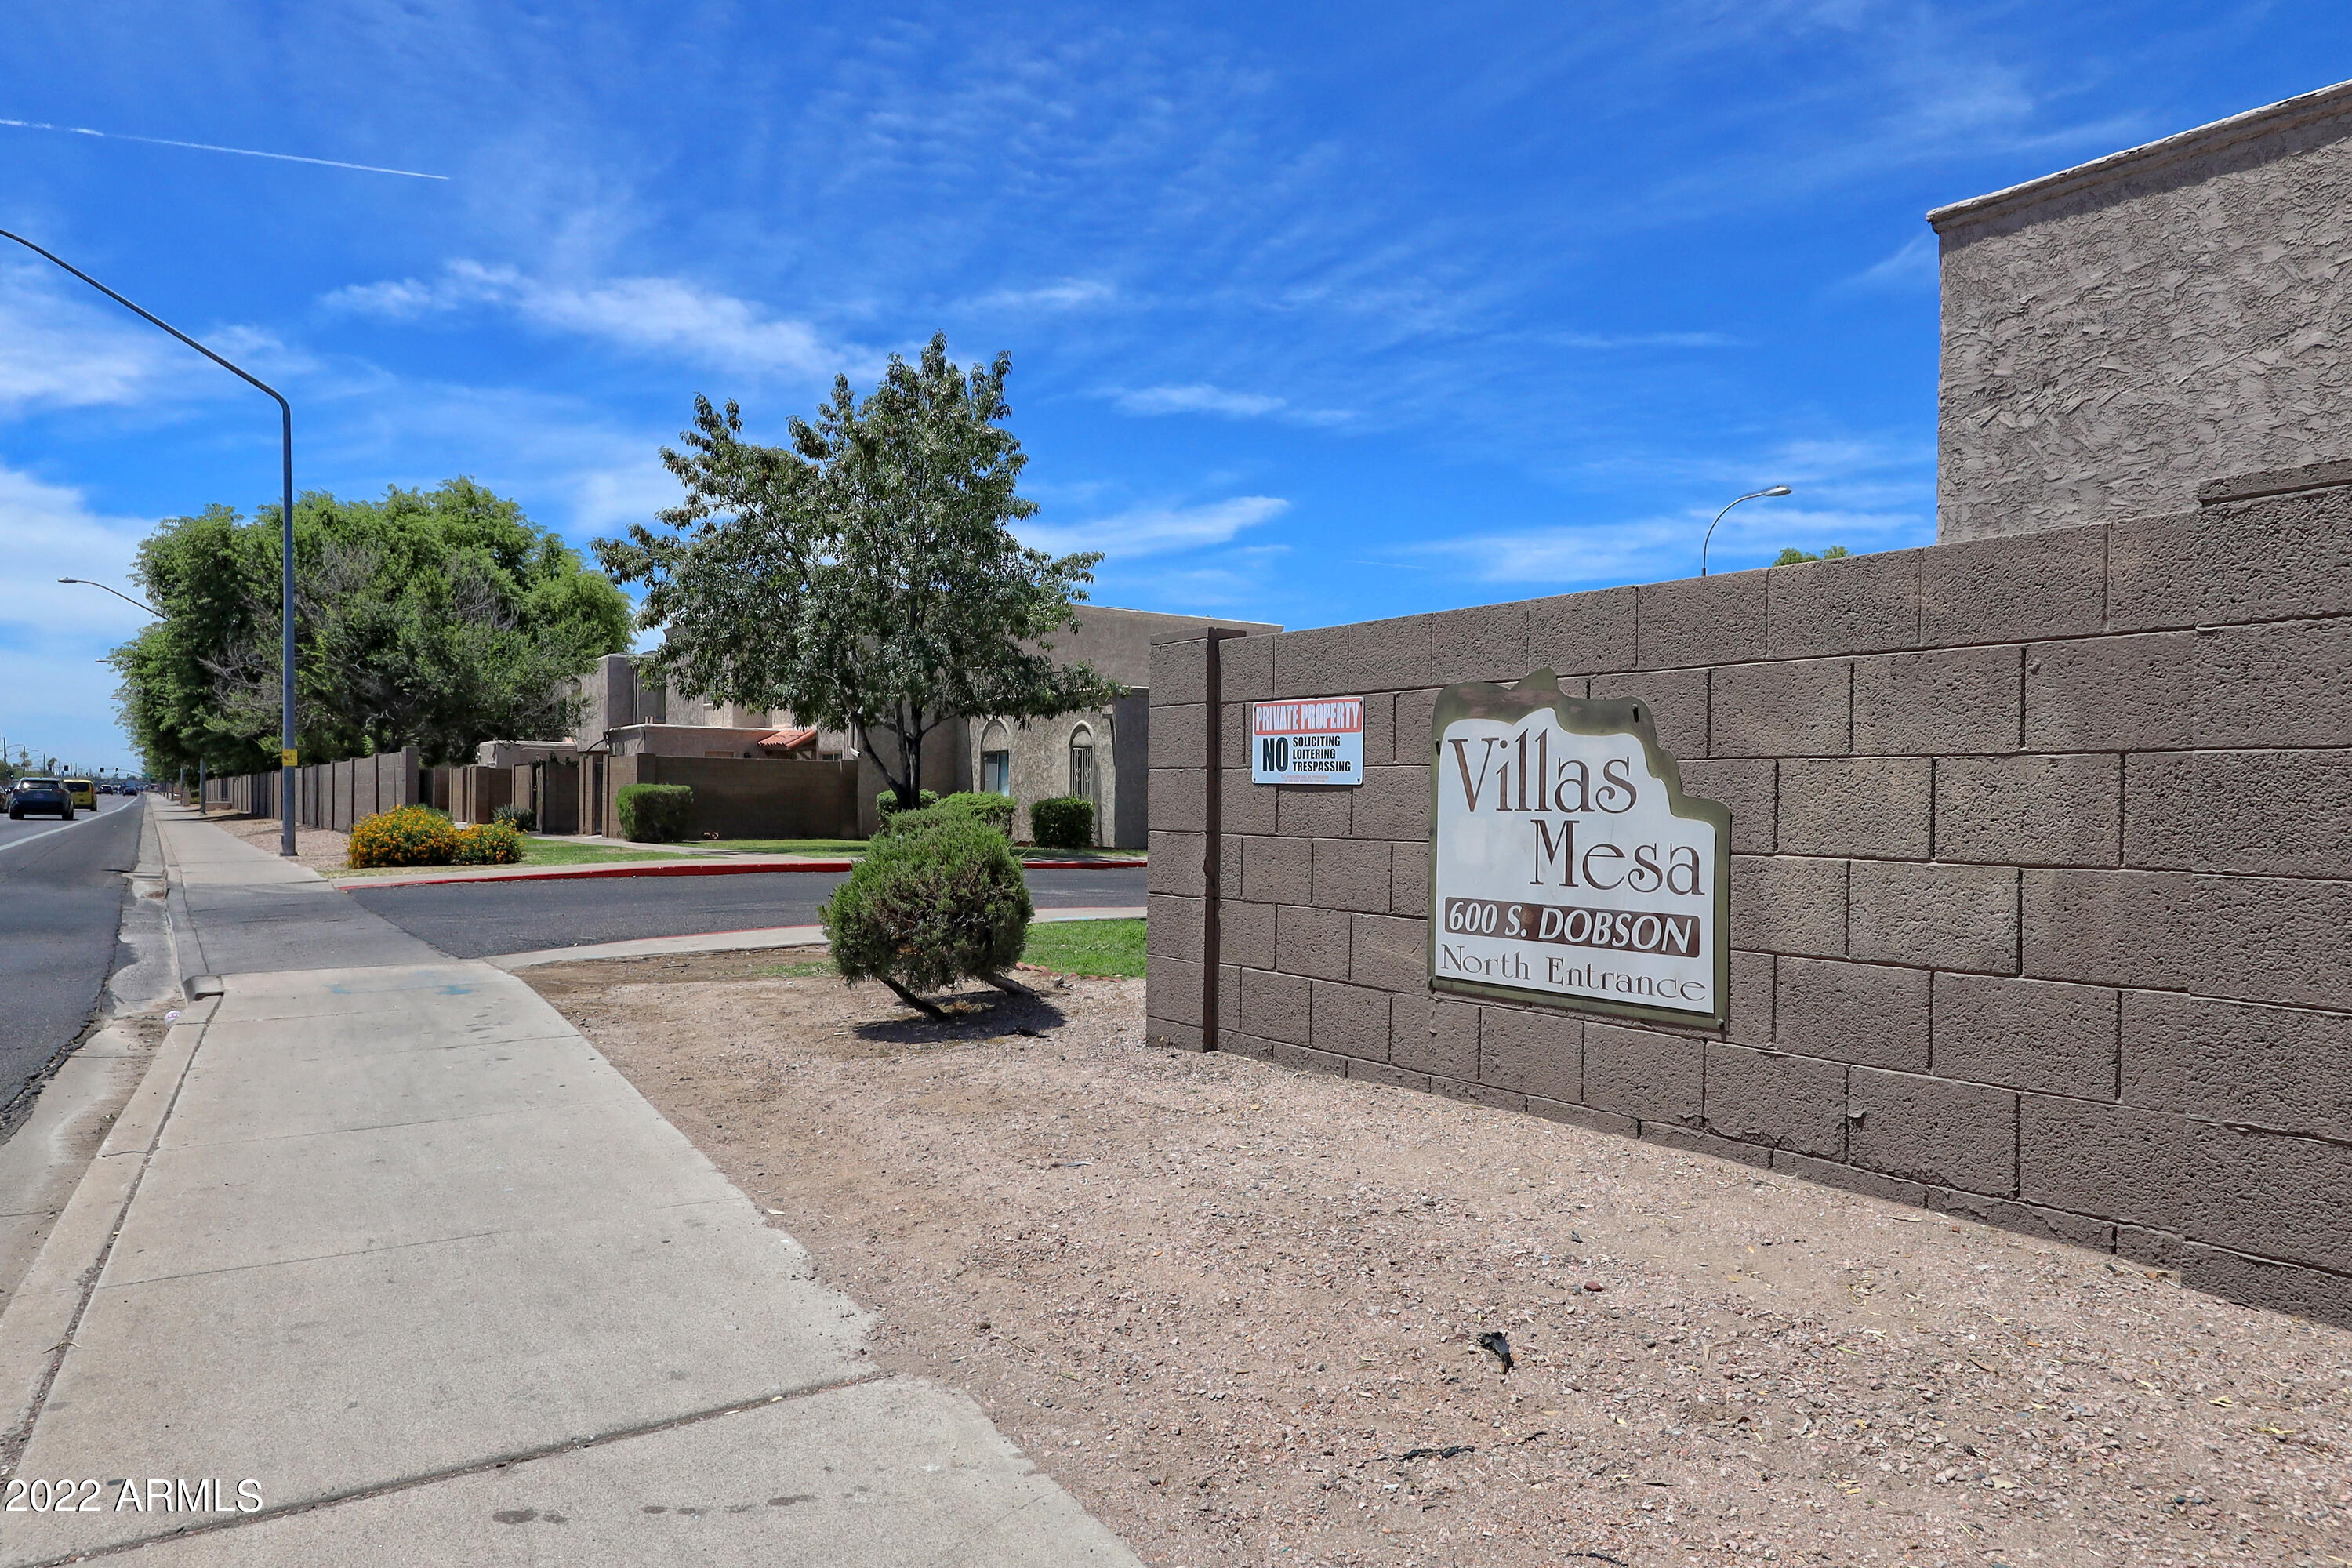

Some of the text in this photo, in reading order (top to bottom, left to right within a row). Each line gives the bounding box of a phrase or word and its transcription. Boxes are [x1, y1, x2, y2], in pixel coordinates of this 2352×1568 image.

[1256, 701, 1360, 731] PRIVATE PROPERTY
[1262, 737, 1289, 772] NO
[1293, 735, 1340, 747] SOLICITING
[1293, 749, 1336, 760] LOITERING
[1293, 760, 1351, 772] TRESPASSING
[1447, 728, 1638, 814] Villas
[1530, 819, 1705, 896] Mesa
[1448, 901, 1693, 954] 600 S. DOBSON
[1440, 944, 1707, 1002] North Entrance
